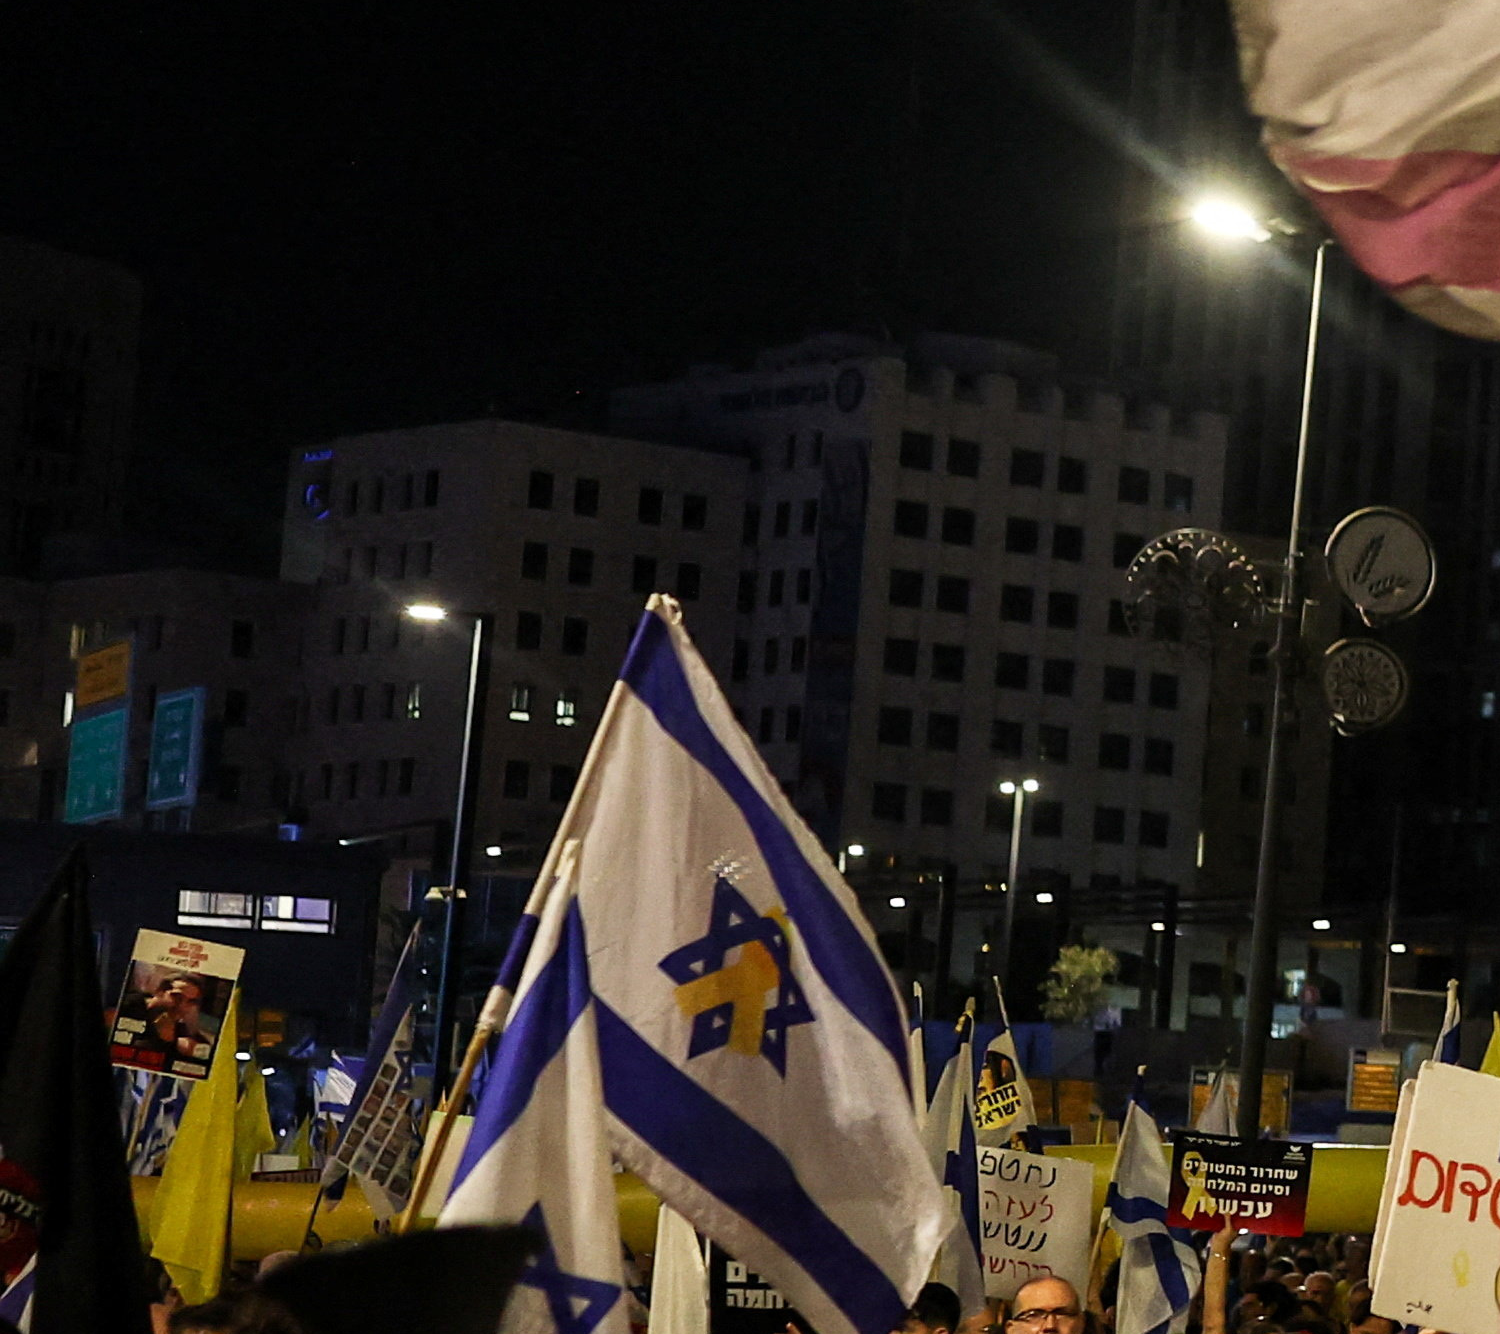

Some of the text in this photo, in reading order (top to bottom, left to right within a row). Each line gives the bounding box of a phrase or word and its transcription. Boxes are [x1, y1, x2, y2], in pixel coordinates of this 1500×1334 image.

[1183, 1159, 1299, 1181] שחרור החטופים
[1249, 1181, 1291, 1197] וסיום
